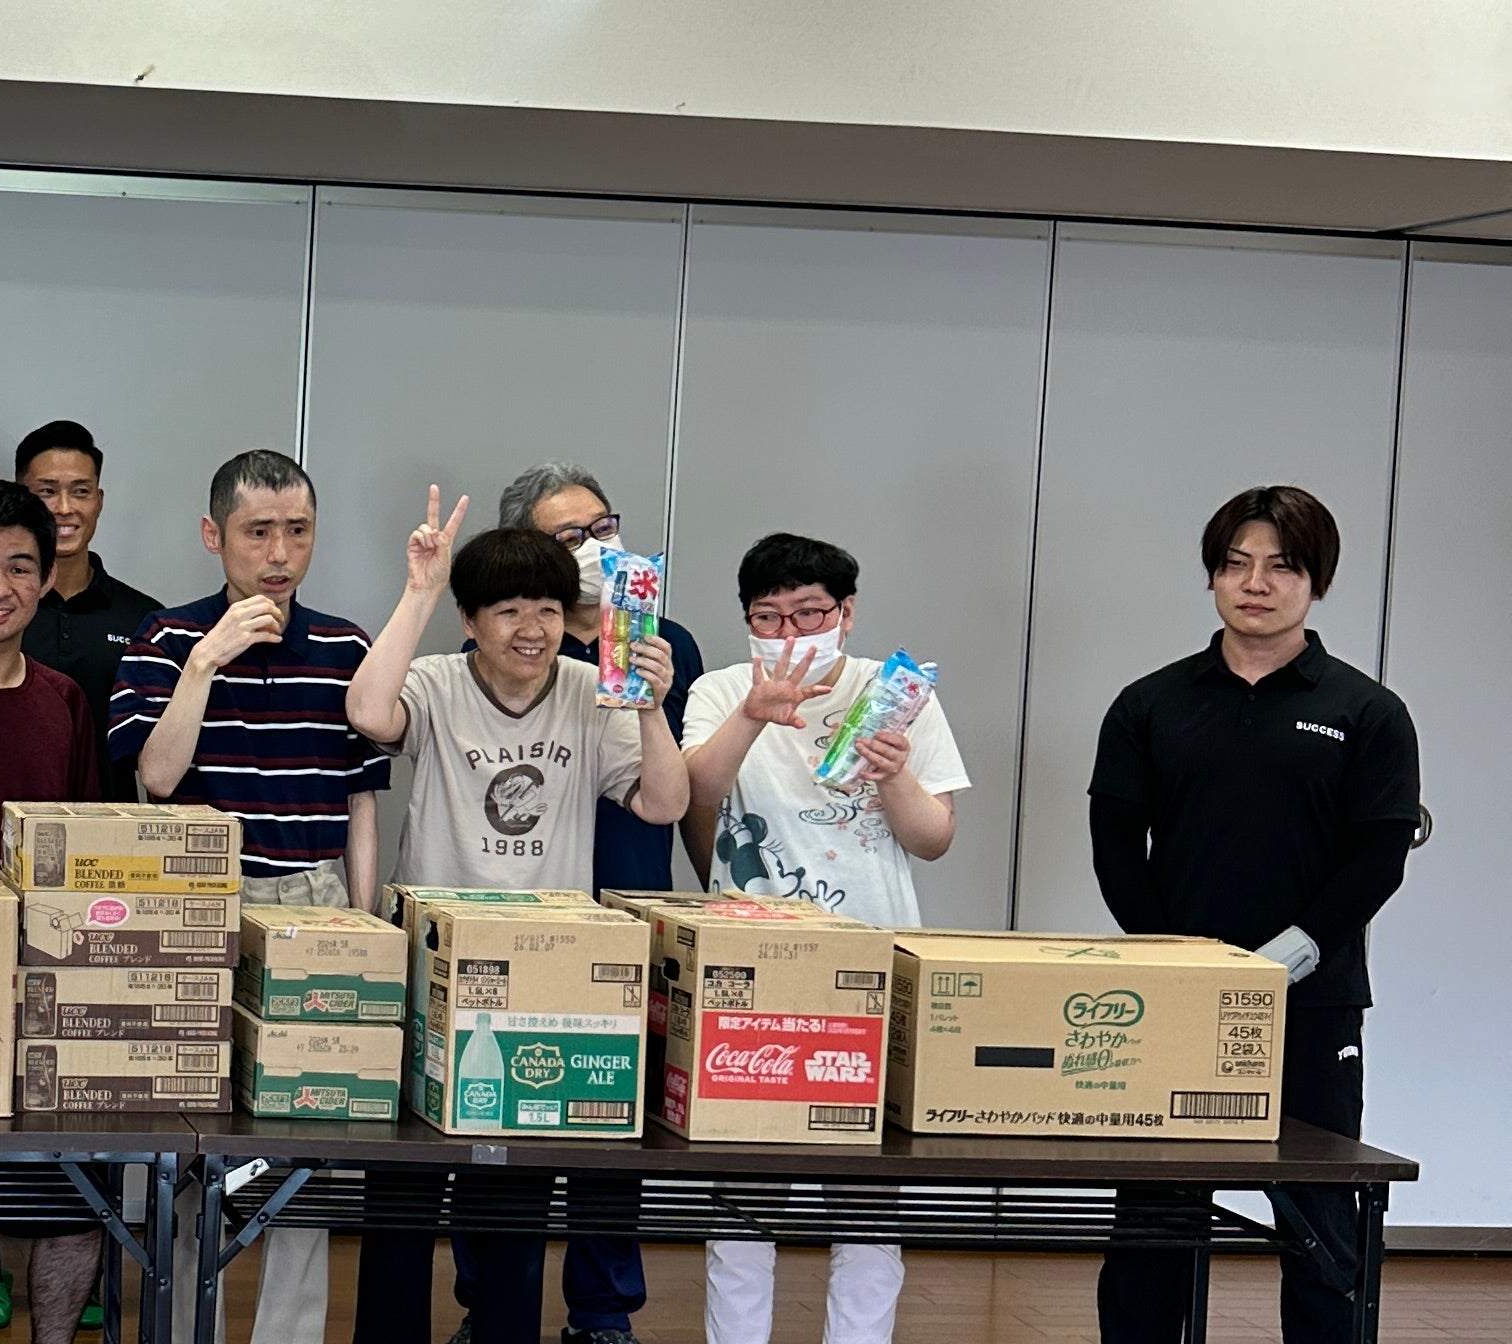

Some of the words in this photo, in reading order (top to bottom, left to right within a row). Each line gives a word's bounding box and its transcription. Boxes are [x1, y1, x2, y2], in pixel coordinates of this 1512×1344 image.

[1295, 721, 1345, 742] SUCCESS
[465, 740, 572, 771] PLAISIR
[481, 836, 544, 857] 1988
[74, 858, 99, 867] UCC
[74, 869, 124, 880] BLENDED
[74, 880, 105, 889] COFFEE
[89, 943, 138, 955] BLENDED
[88, 955, 119, 964] COFFEE
[320, 991, 356, 1000] MITSUYA
[1220, 992, 1273, 1007] 51590
[329, 1000, 355, 1008] CIDER
[1073, 1002, 1136, 1020] ライフリー
[62, 1017, 111, 1029] BLENDED
[507, 1016, 558, 1028] 甘さ控えめ
[718, 1016, 826, 1034] 限定アイテム当たる!
[1228, 1026, 1263, 1039] 45枚
[1064, 1029, 1128, 1050] さわやか
[1223, 1042, 1266, 1056] 12袋入
[510, 1056, 566, 1068] CANADA
[570, 1054, 632, 1070] GINGER
[705, 1042, 802, 1076] Coca-Cola
[804, 1050, 872, 1068] STAR
[524, 1068, 551, 1079] DRY
[587, 1071, 615, 1085] ALE
[711, 1075, 756, 1083] ORIGINAL
[758, 1075, 789, 1084] TASTE
[804, 1065, 872, 1083] WARS
[63, 1090, 112, 1101] BLENDED
[310, 1088, 346, 1097] MITSUYA
[62, 1101, 92, 1110] COFFEE
[319, 1097, 346, 1106] CIDER
[528, 1112, 551, 1123] 1.5L
